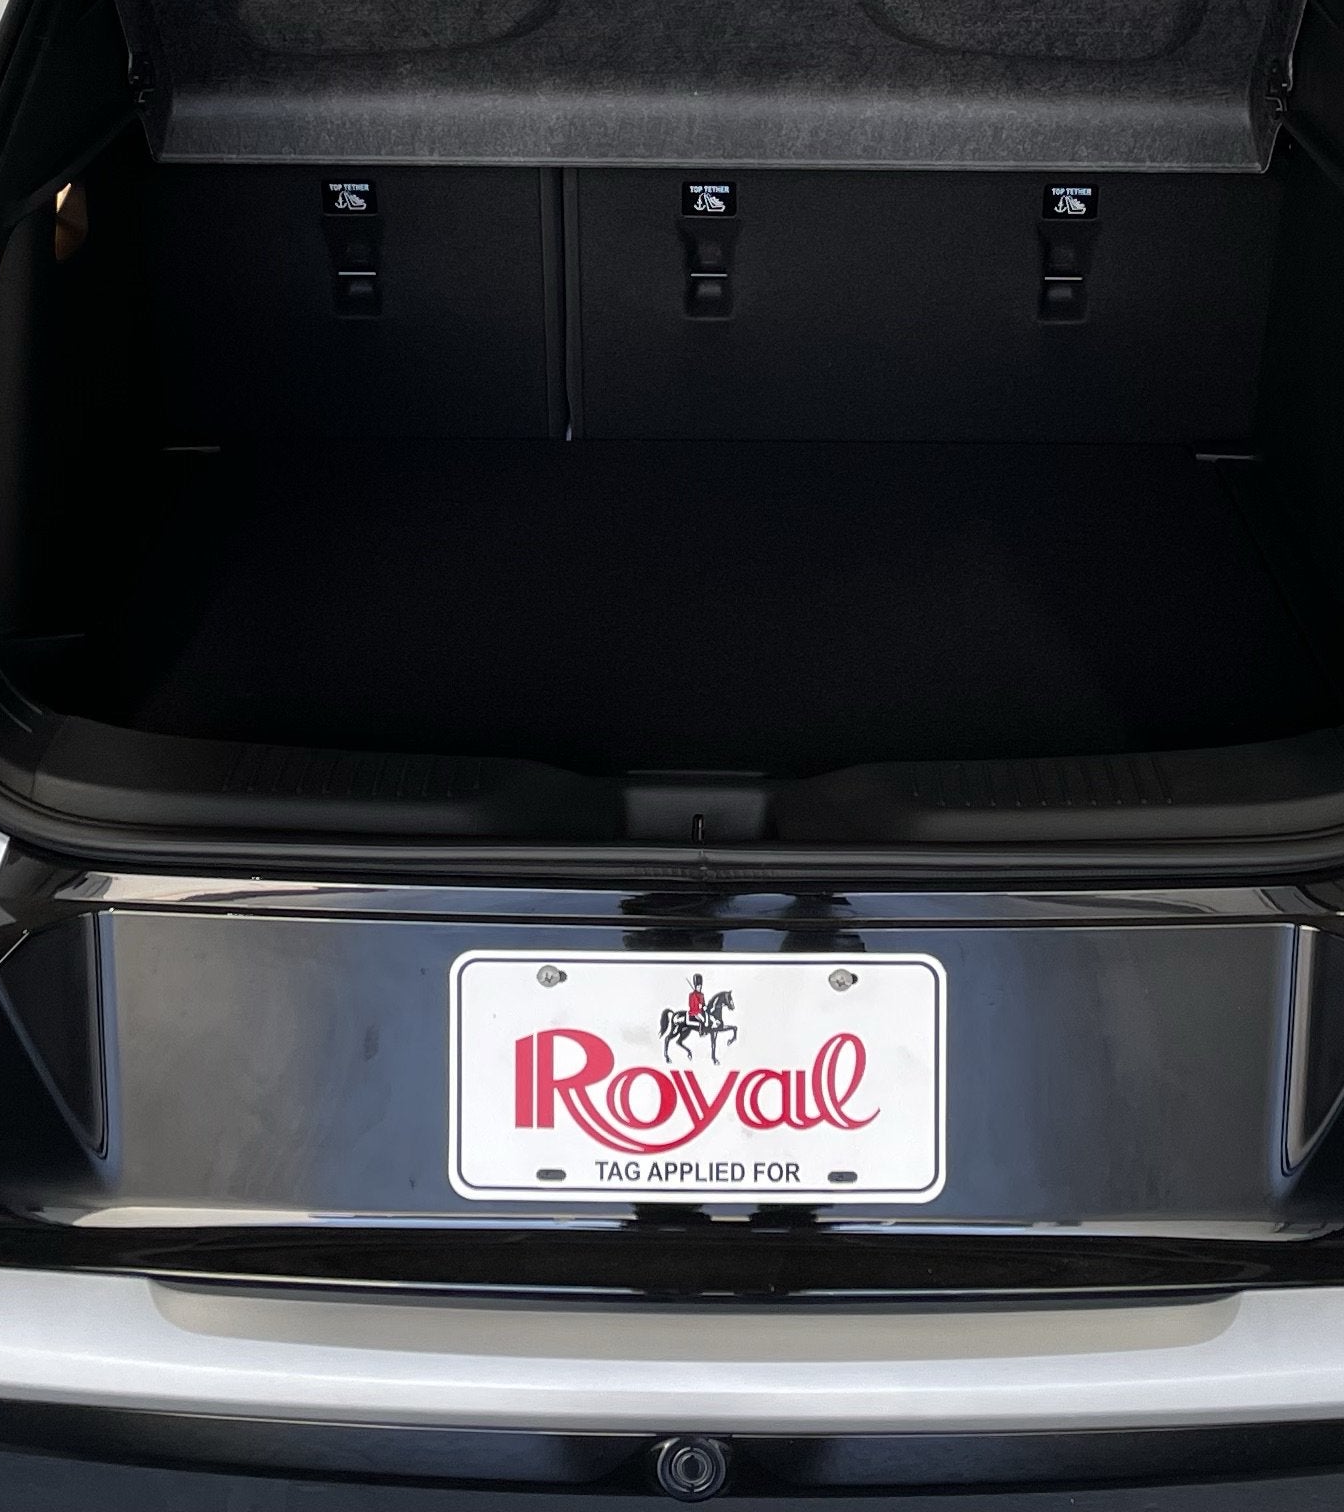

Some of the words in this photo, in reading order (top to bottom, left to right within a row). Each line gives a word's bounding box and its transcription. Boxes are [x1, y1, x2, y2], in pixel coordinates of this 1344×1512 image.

[689, 185, 703, 193] TOP
[515, 1028, 881, 1155] Royal
[594, 1161, 641, 1182] TAG
[647, 1162, 746, 1183] APPLIED
[753, 1162, 801, 1183] FOR
